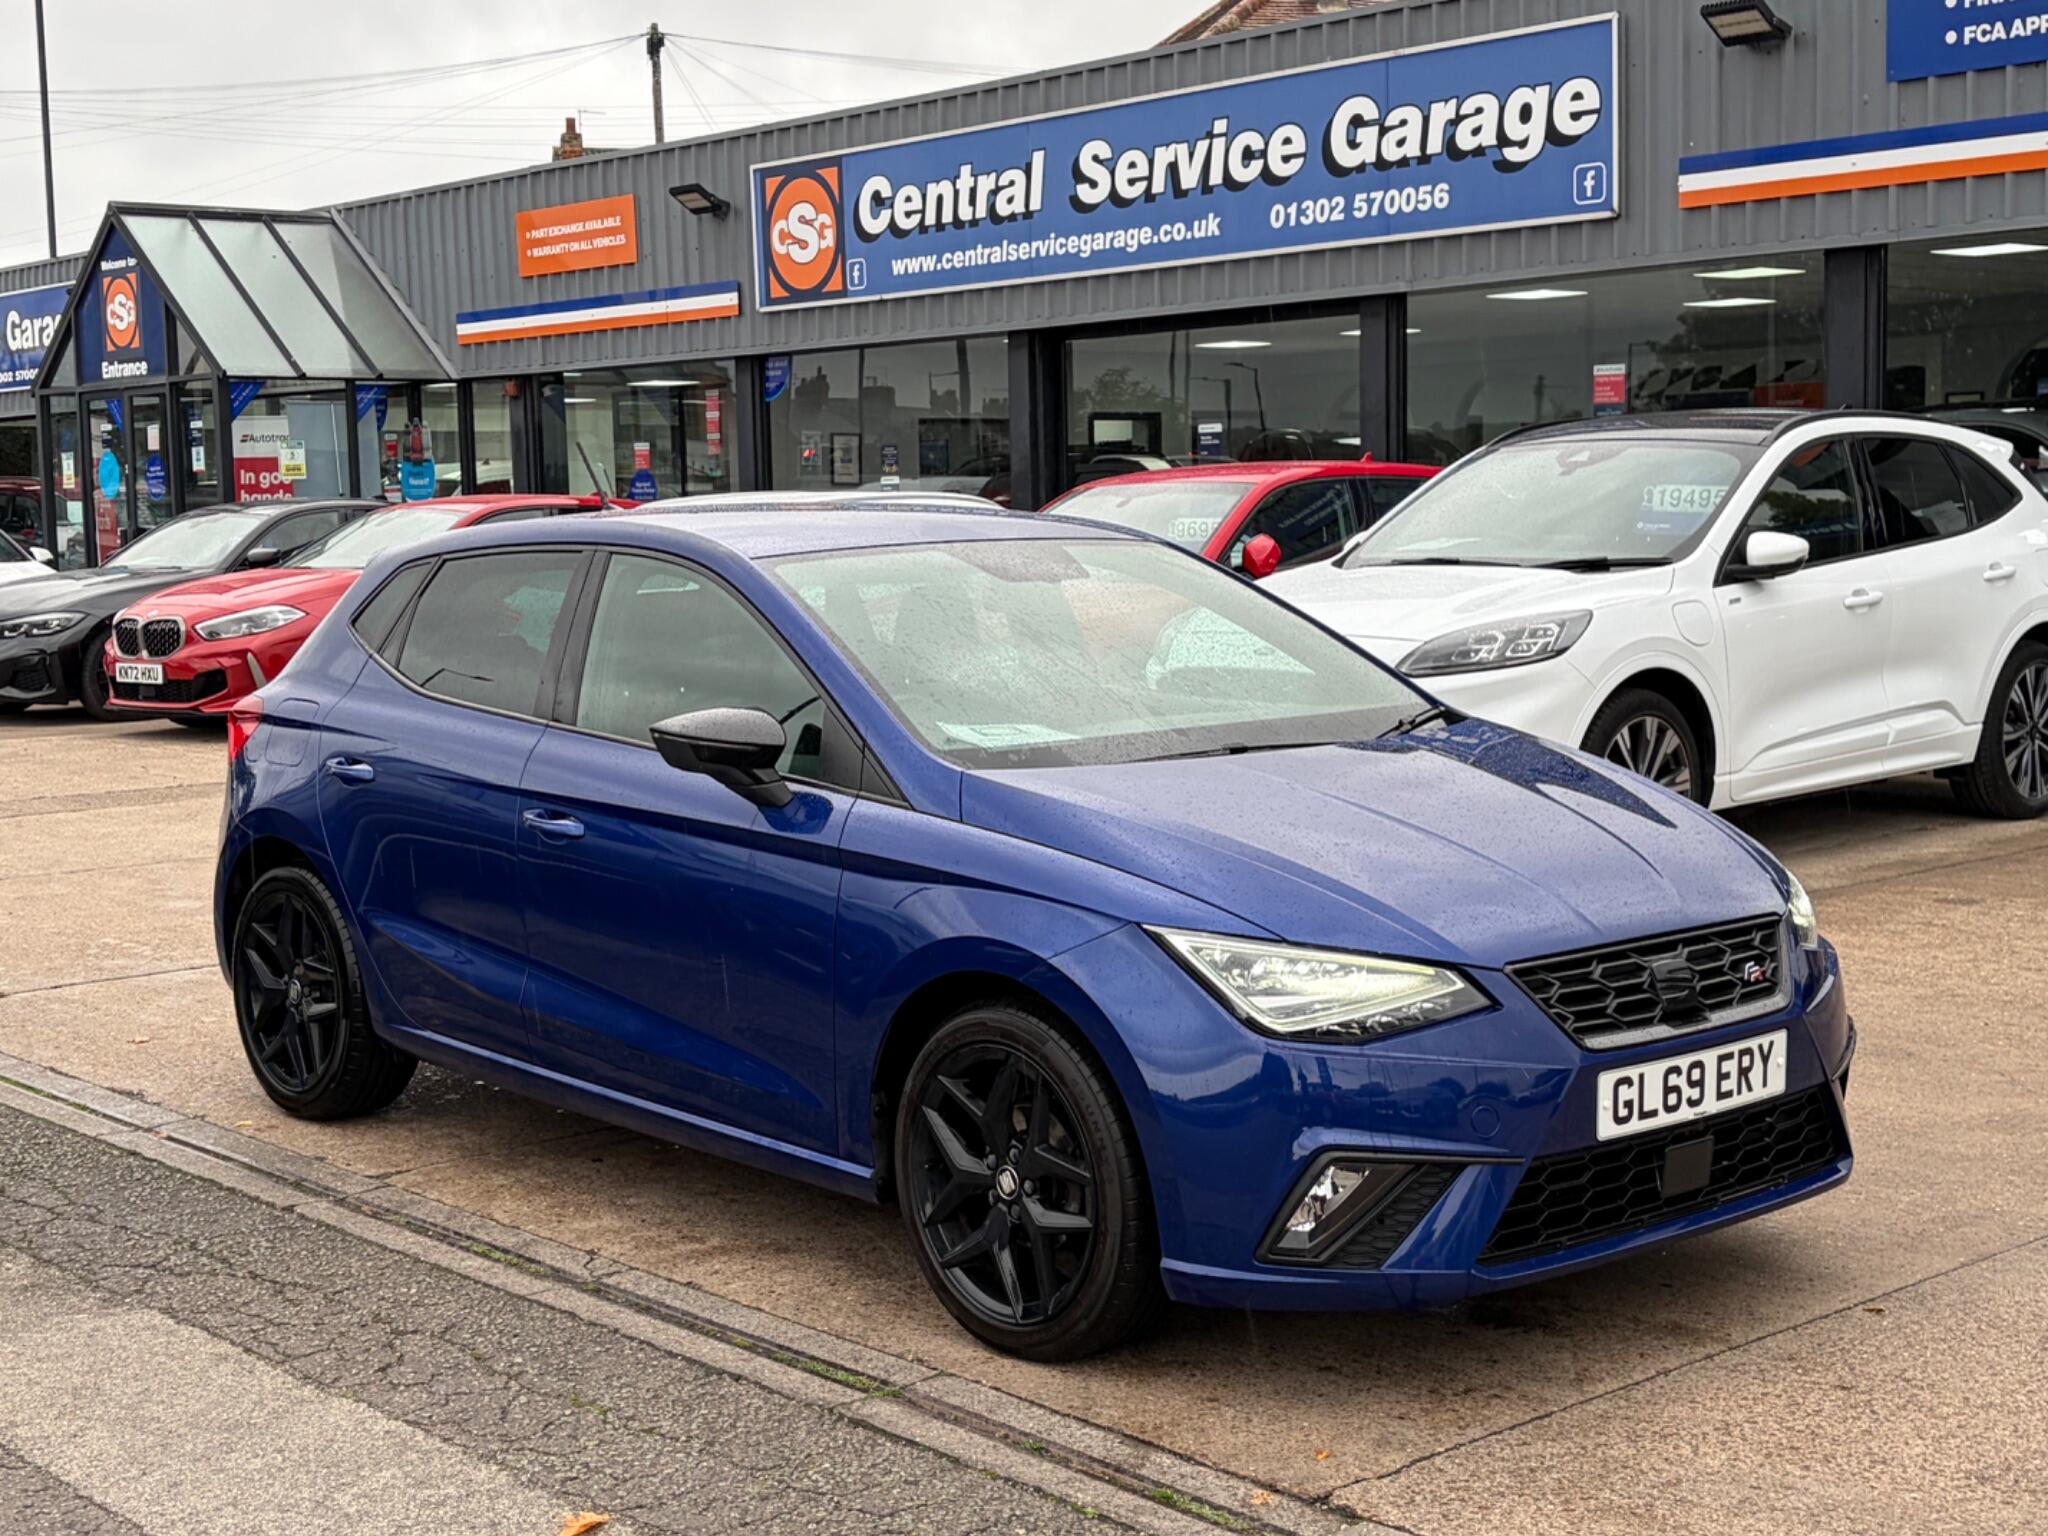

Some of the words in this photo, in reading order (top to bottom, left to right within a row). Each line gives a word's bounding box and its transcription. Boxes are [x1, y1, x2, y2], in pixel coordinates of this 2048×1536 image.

[1963, 20, 2007, 45] FCA
[858, 151, 1046, 243] Central
[1074, 119, 1306, 214] Service
[1328, 76, 1602, 171] Garage
[1270, 196, 1345, 229] 01302
[1352, 183, 1450, 218] 570056
[585, 216, 621, 229] AVAILABLE
[532, 243, 569, 258] WARRANTY
[592, 234, 626, 248] VEHICLES
[891, 214, 1222, 277] www.centralservicegarage.co.uk
[6, 310, 62, 351] Gara
[101, 361, 148, 379] Entrance
[240, 469, 256, 485] In
[140, 667, 158, 681] HXU
[1612, 1060, 1707, 1126] GL69
[1716, 1040, 1775, 1102] ERY
